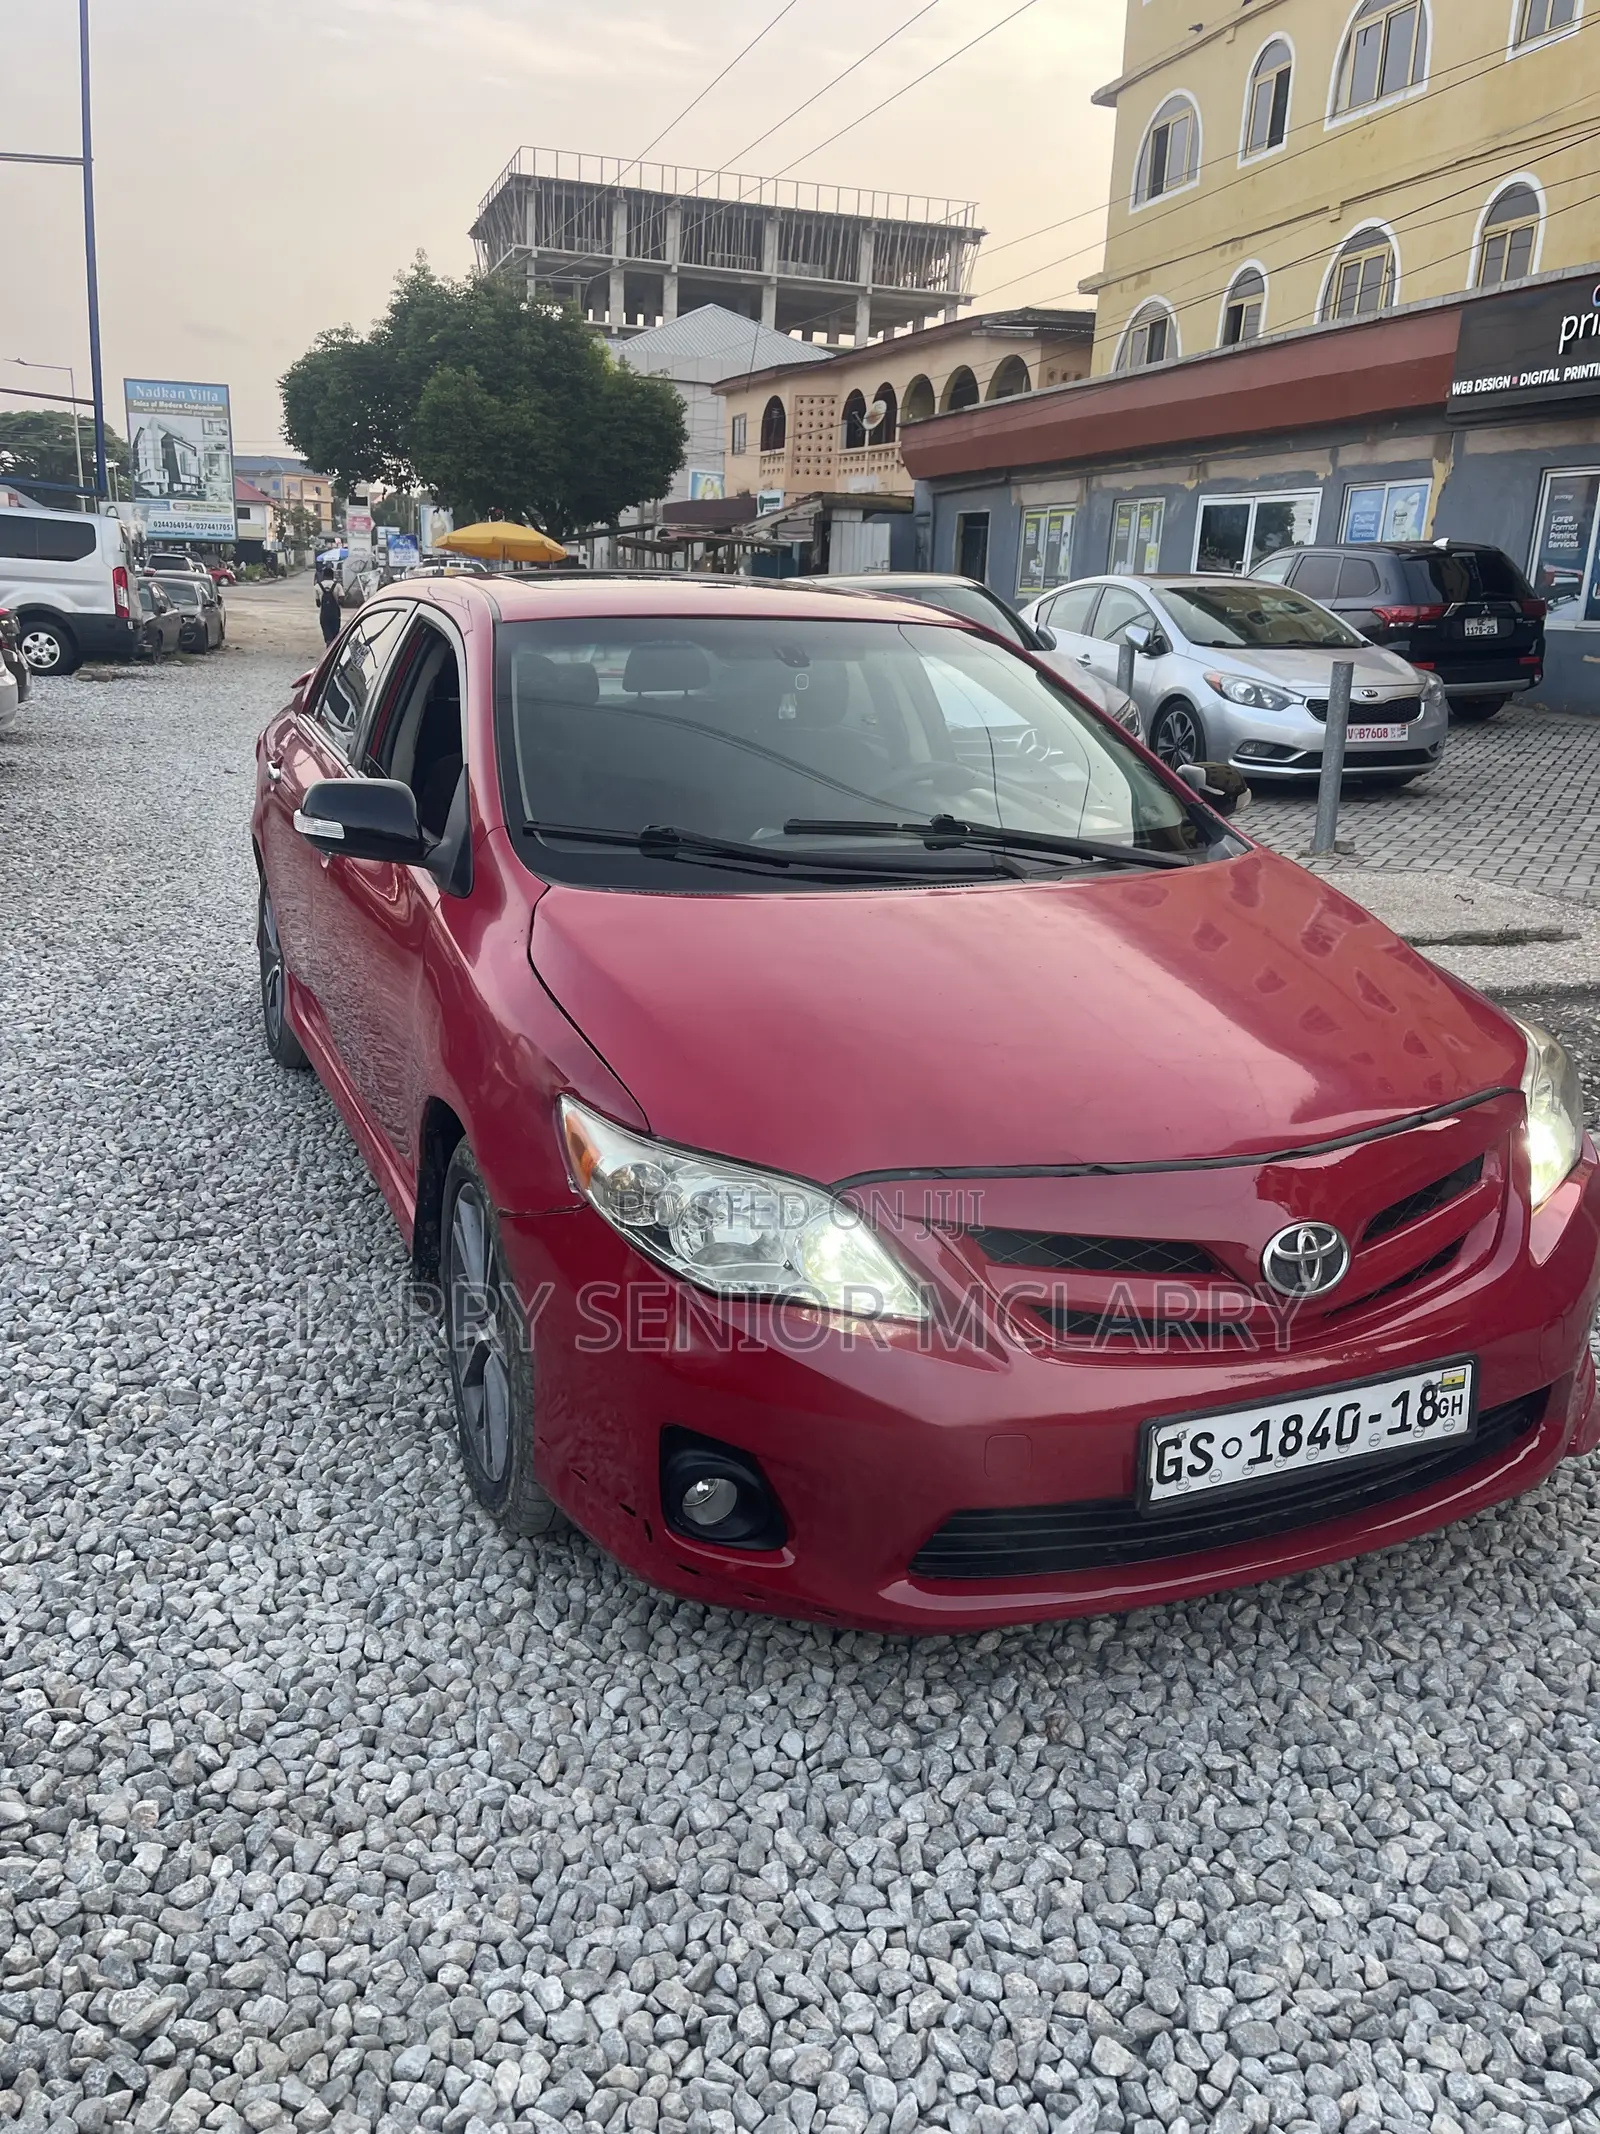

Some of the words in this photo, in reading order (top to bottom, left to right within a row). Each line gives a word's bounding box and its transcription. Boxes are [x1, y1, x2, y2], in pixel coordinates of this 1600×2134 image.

[1558, 312, 1600, 355] pri
[1452, 380, 1473, 396] WEB
[1474, 375, 1511, 393] DESIGN
[1519, 368, 1560, 386] DIGITAL
[1563, 362, 1600, 381] PRINTI
[136, 385, 185, 399] Nadkan
[189, 388, 218, 402] Villa
[1552, 515, 1574, 523] Large
[1550, 523, 1578, 531] Format
[1549, 532, 1578, 541] Printing
[1548, 540, 1579, 549] Services
[1348, 728, 1354, 739] V
[1155, 1431, 1215, 1486] GS
[1247, 1384, 1439, 1466] 1840-18
[1438, 1394, 1463, 1419] GH
